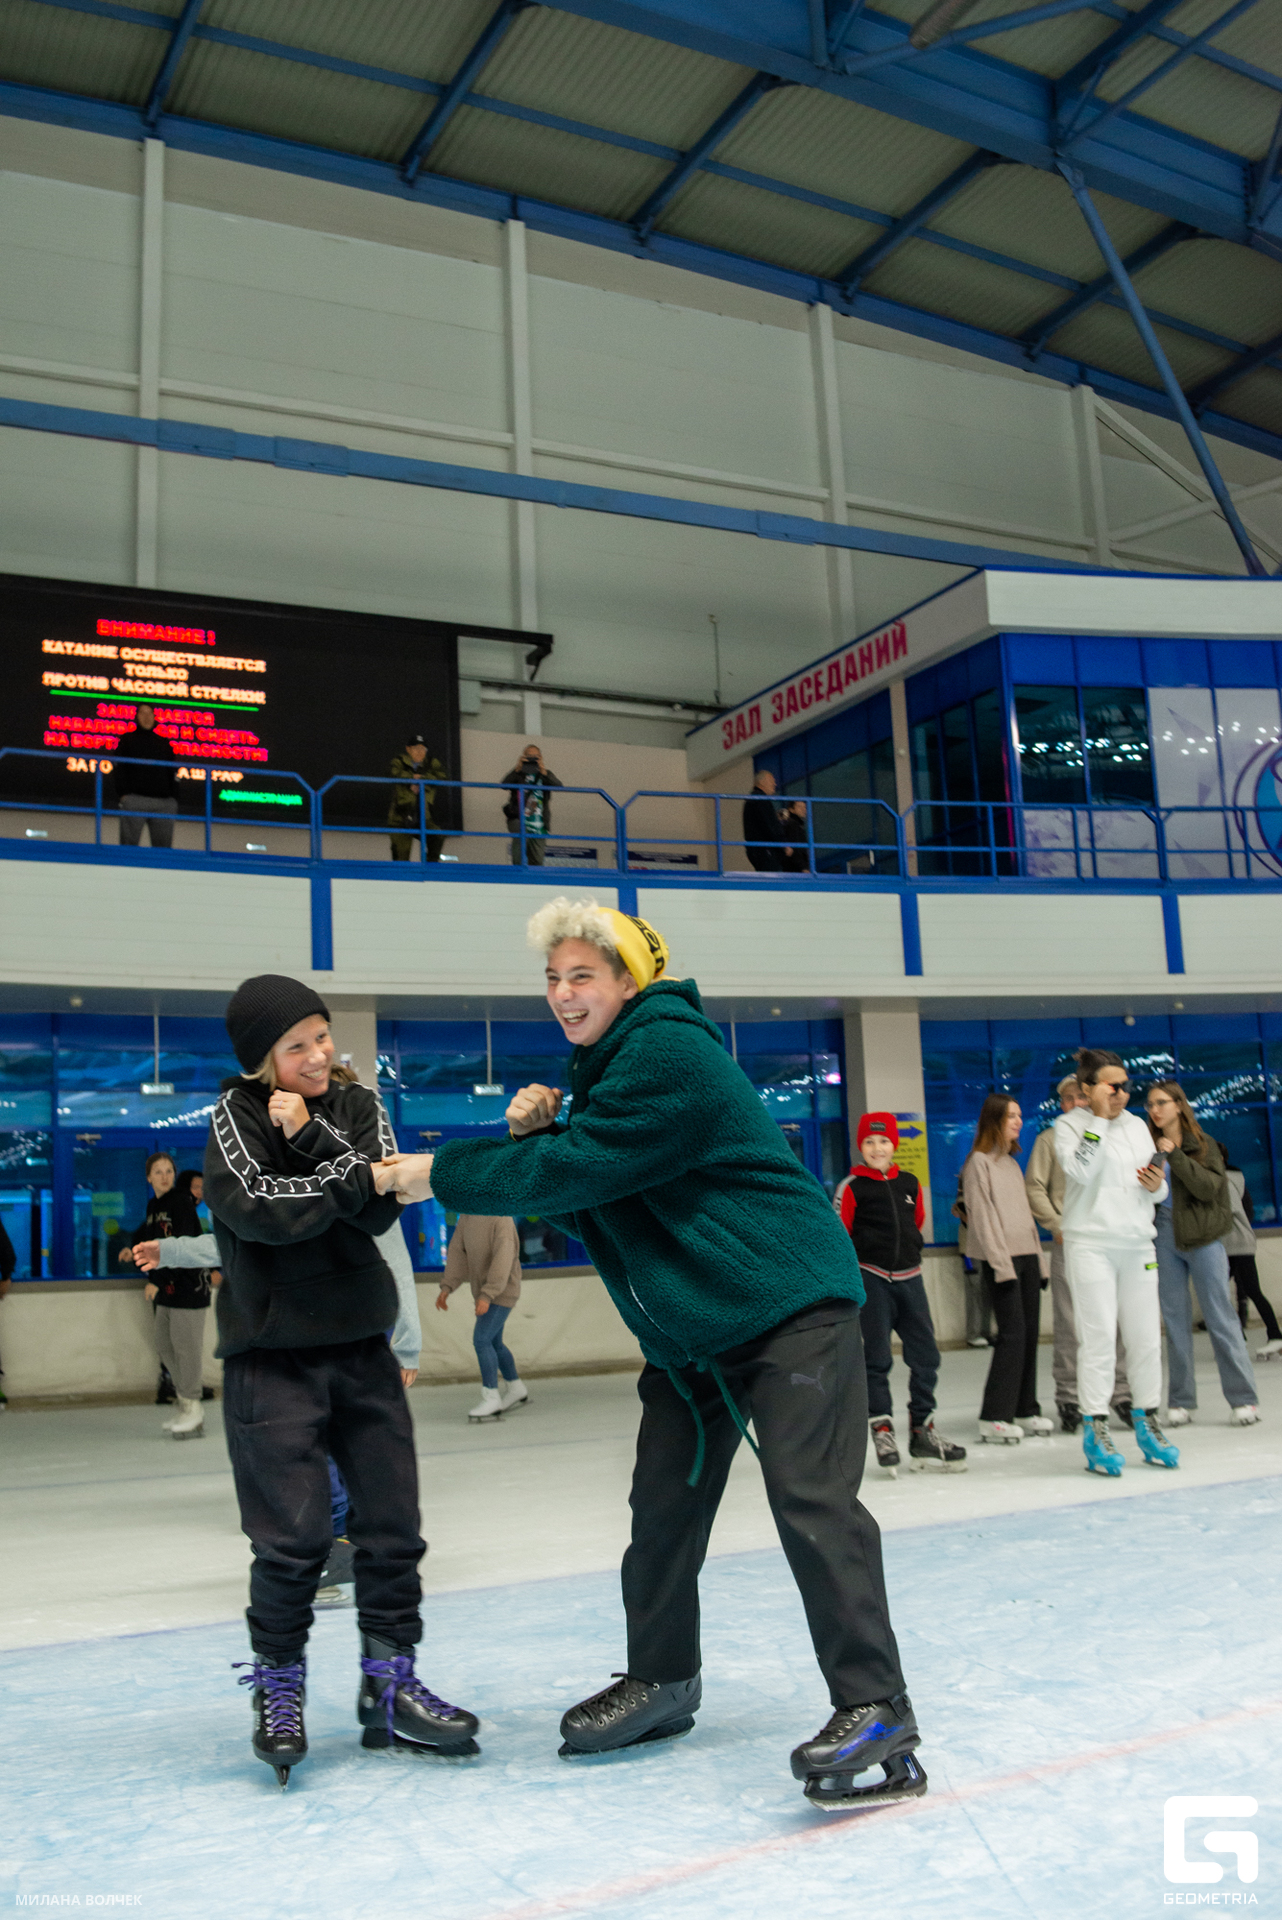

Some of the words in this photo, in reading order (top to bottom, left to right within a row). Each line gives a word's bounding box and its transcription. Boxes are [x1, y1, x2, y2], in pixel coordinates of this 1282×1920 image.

[42, 639, 118, 659] КАТАНИЕ
[120, 647, 267, 672] ОСУЩЕСТВЛЯЕТСЯ
[123, 662, 189, 681] ТОЛЬКО
[42, 671, 109, 691] ПРОТИВ
[111, 676, 189, 698] ЧАСОВОЙ
[722, 704, 762, 750] ЗАЛ
[771, 618, 908, 725] ЗАСЕДАНИЙ
[44, 730, 69, 747] НА
[180, 725, 194, 741] И
[195, 727, 260, 745] СИДЕТЬ
